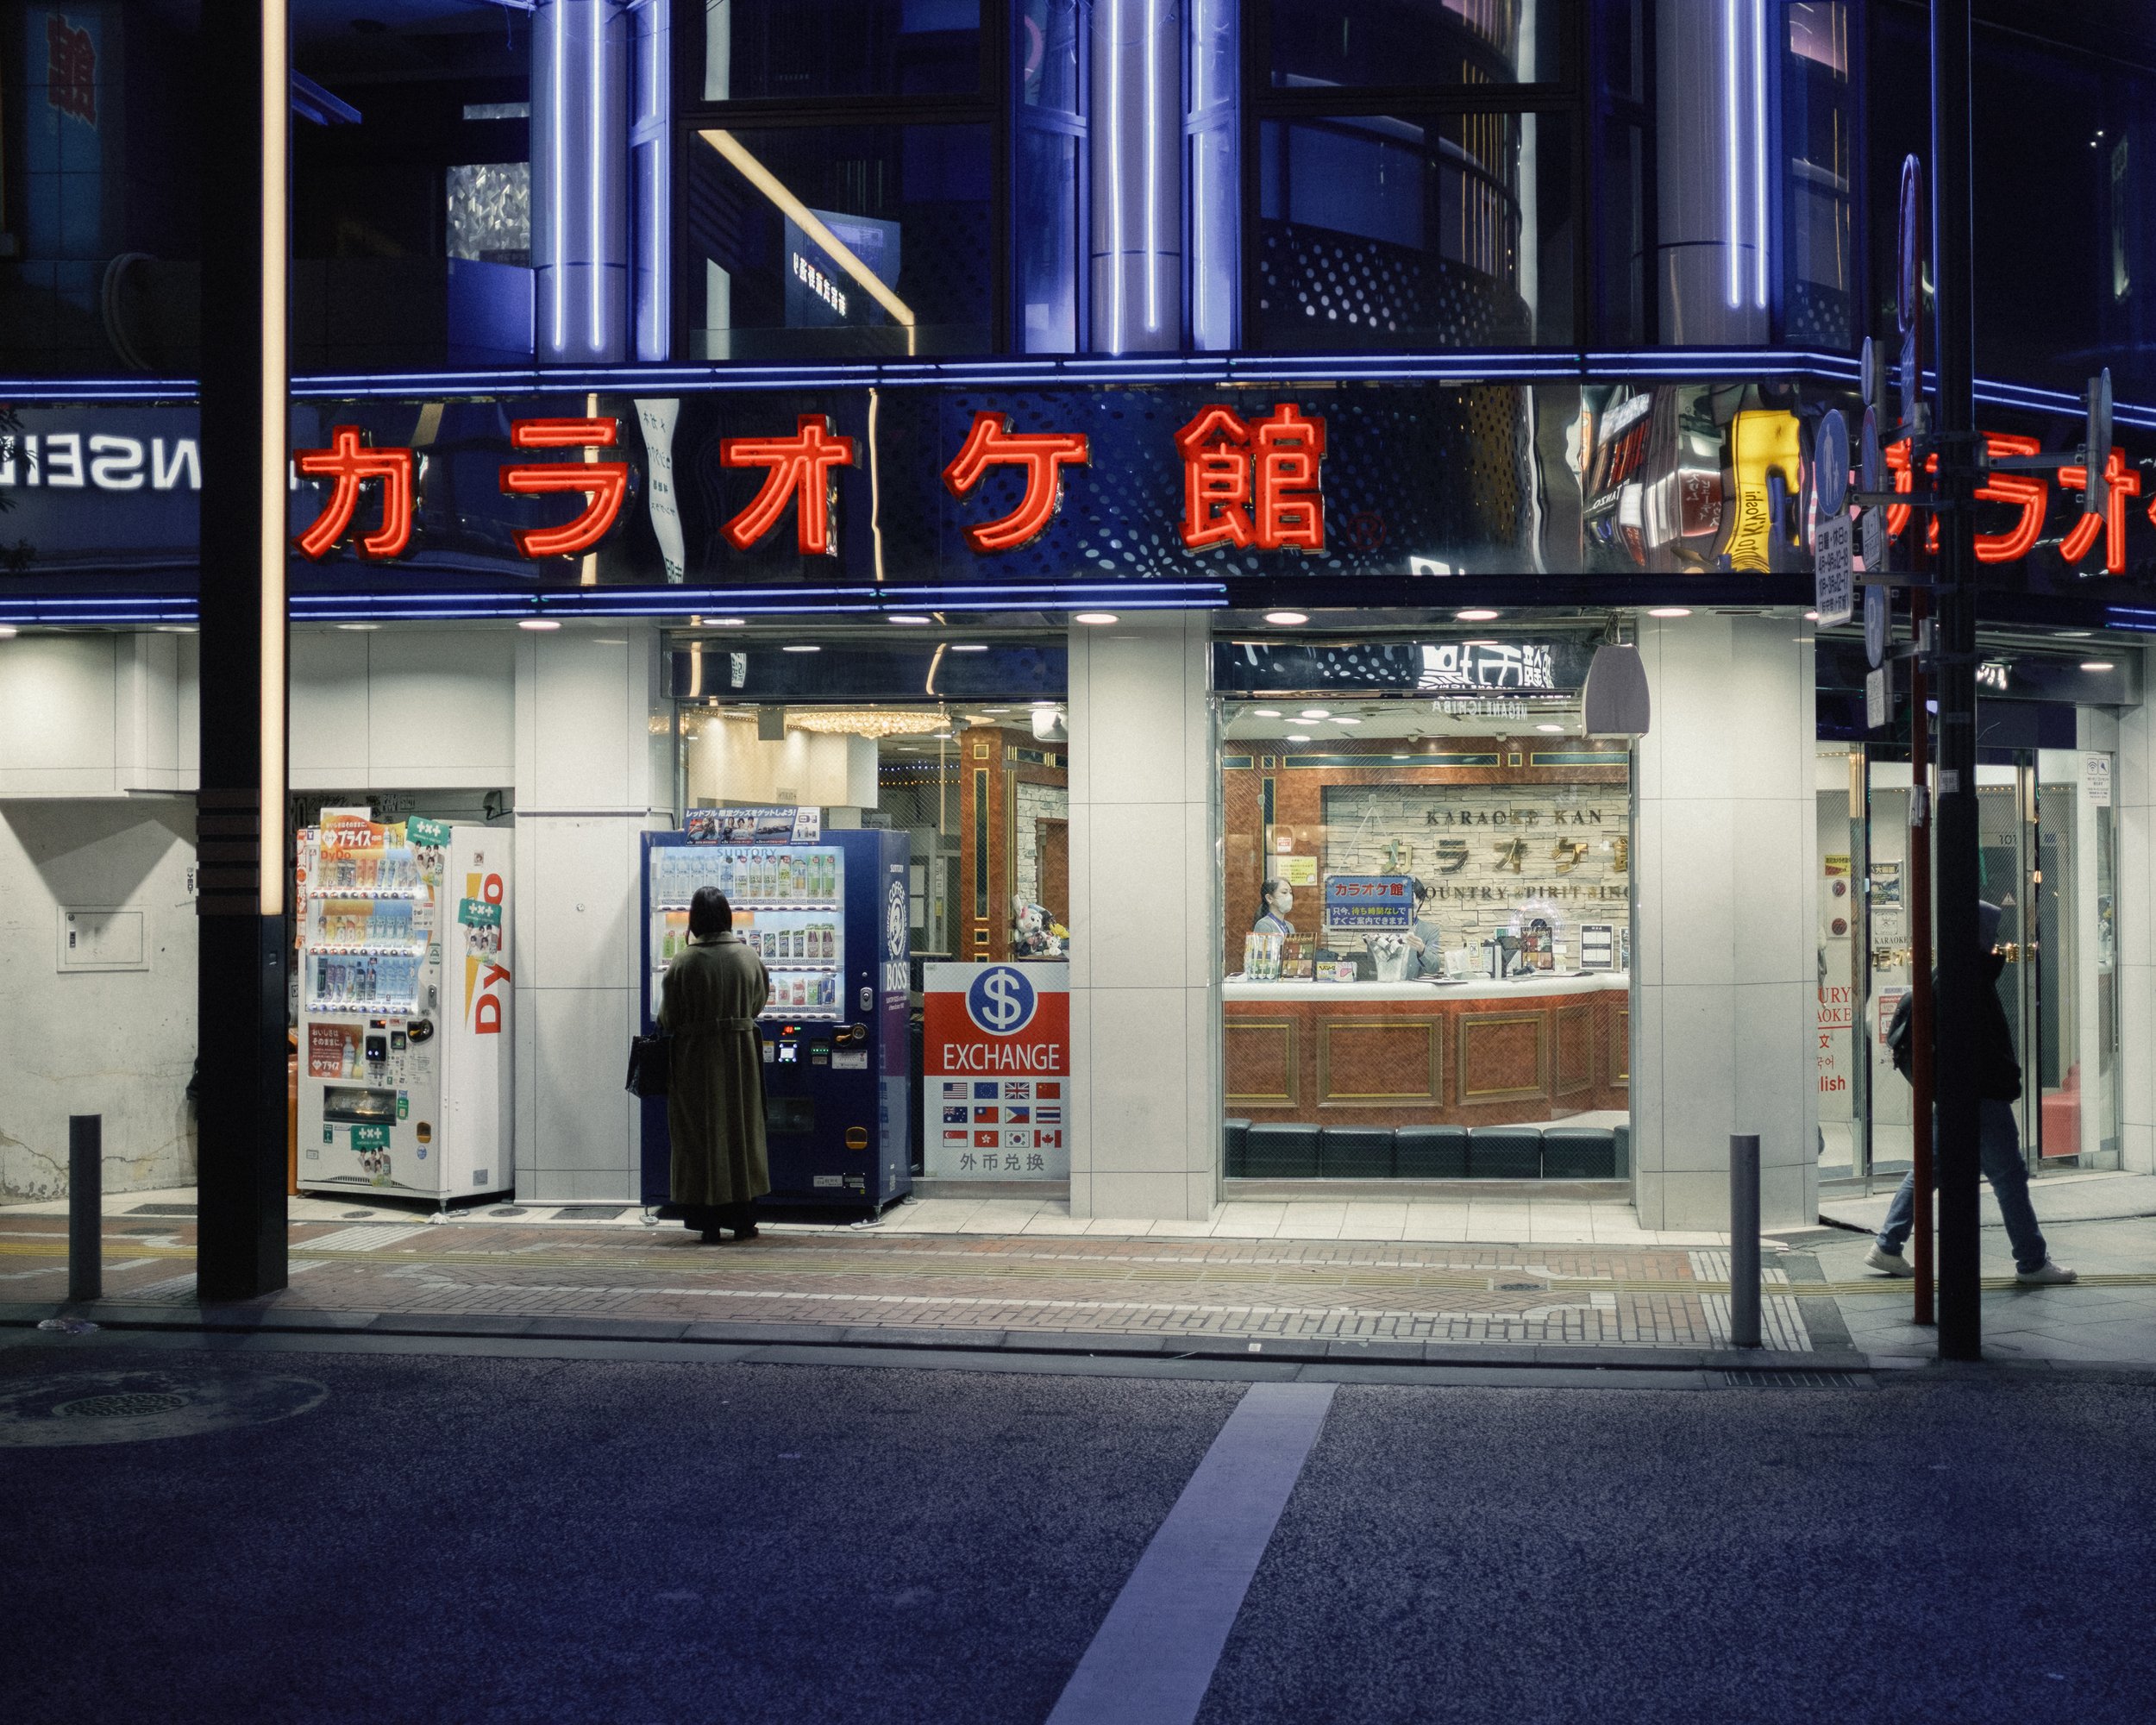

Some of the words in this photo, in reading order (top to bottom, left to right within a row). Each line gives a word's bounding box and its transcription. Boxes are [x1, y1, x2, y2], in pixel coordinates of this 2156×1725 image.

[291, 404, 1328, 561] カラオケ館
[1885, 431, 2156, 576] カラオ
[1426, 811, 1539, 825] KARAOKE
[1554, 810, 1602, 825] KAN
[321, 850, 352, 862] DyDo
[718, 848, 776, 856] SUNTORY
[1335, 883, 1404, 896] カラオケ館
[1425, 887, 1507, 900] OUNTRY
[1332, 906, 1407, 916] 只今、待ち時間なしで
[1332, 917, 1407, 925] すぐご案内できます。
[1874, 937, 1908, 945] KARAOKE
[475, 873, 511, 1034] Dyo
[886, 963, 907, 991] BOSS
[1818, 987, 1852, 1004] URY
[943, 1044, 1060, 1070] EXCHANGE
[1817, 1075, 1846, 1094] lish
[960, 1153, 1045, 1171] 外币兑换
